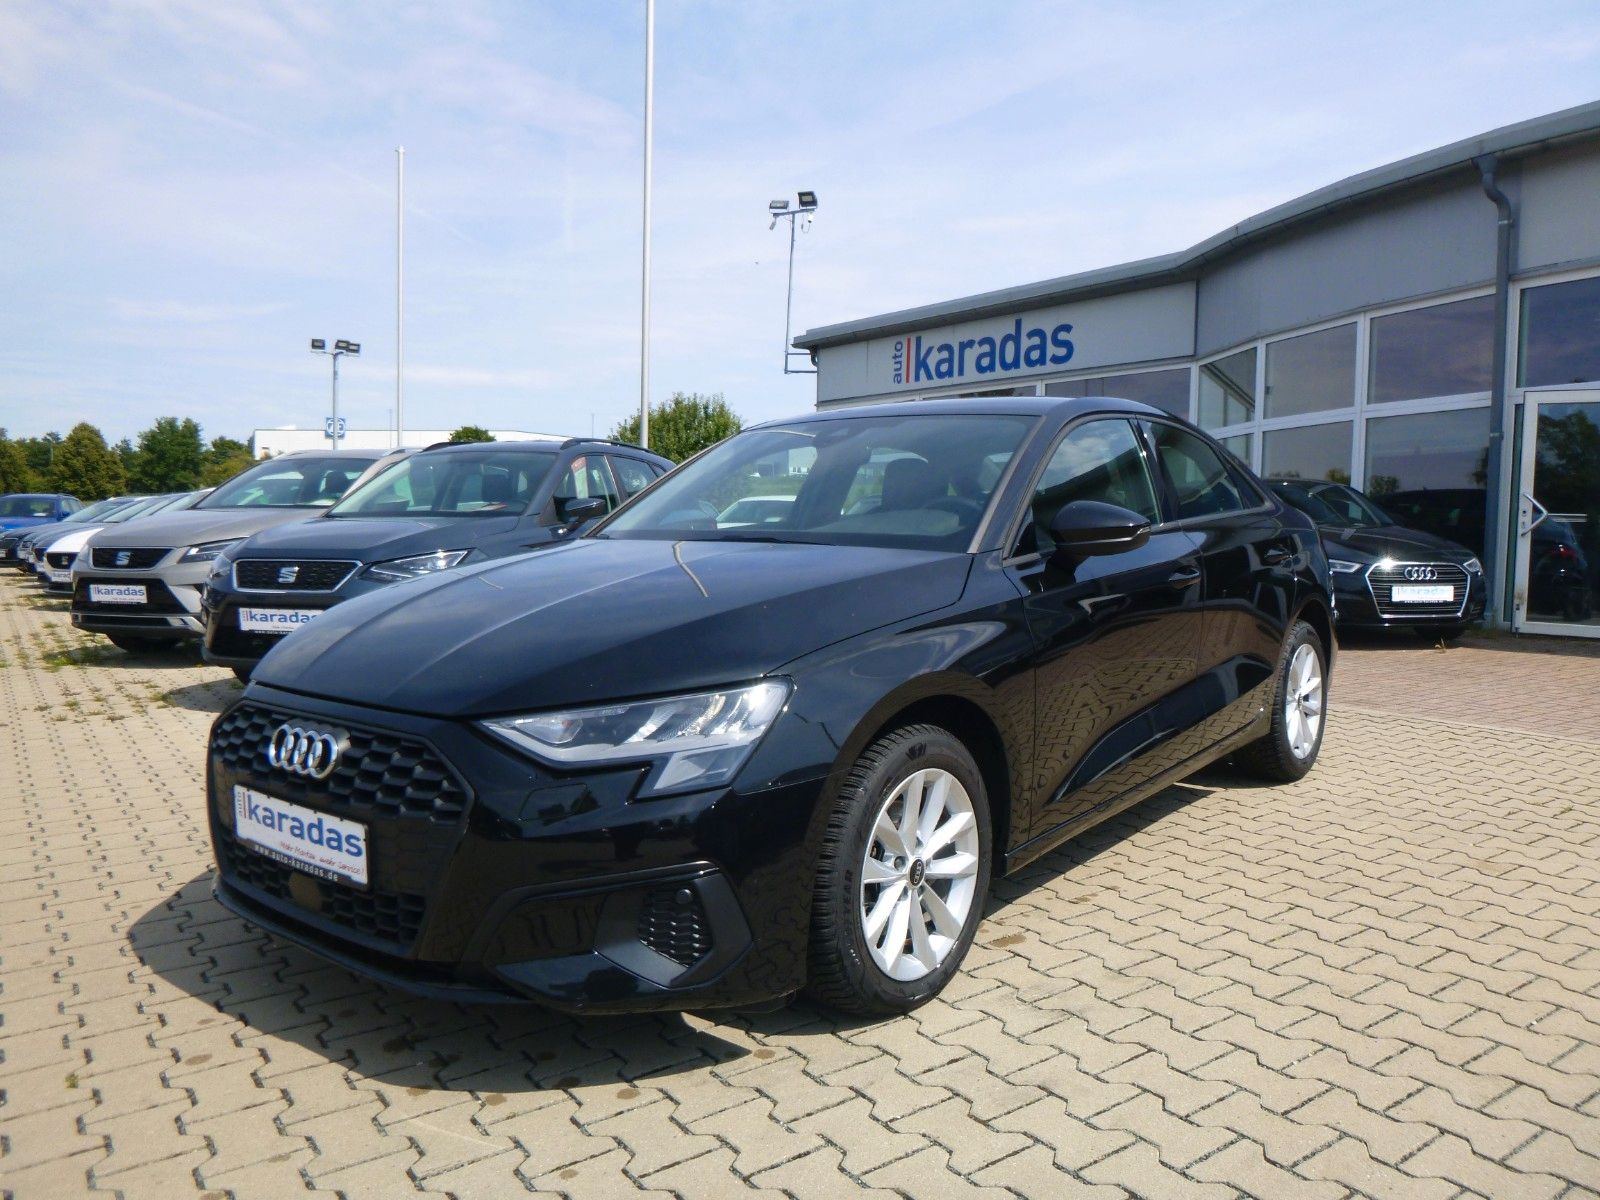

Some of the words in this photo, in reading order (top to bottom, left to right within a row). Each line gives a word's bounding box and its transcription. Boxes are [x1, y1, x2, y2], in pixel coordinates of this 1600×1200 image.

[892, 340, 903, 385] auto
[914, 318, 1075, 383] karadas
[96, 586, 145, 596] karadas
[247, 794, 363, 858] karadas
